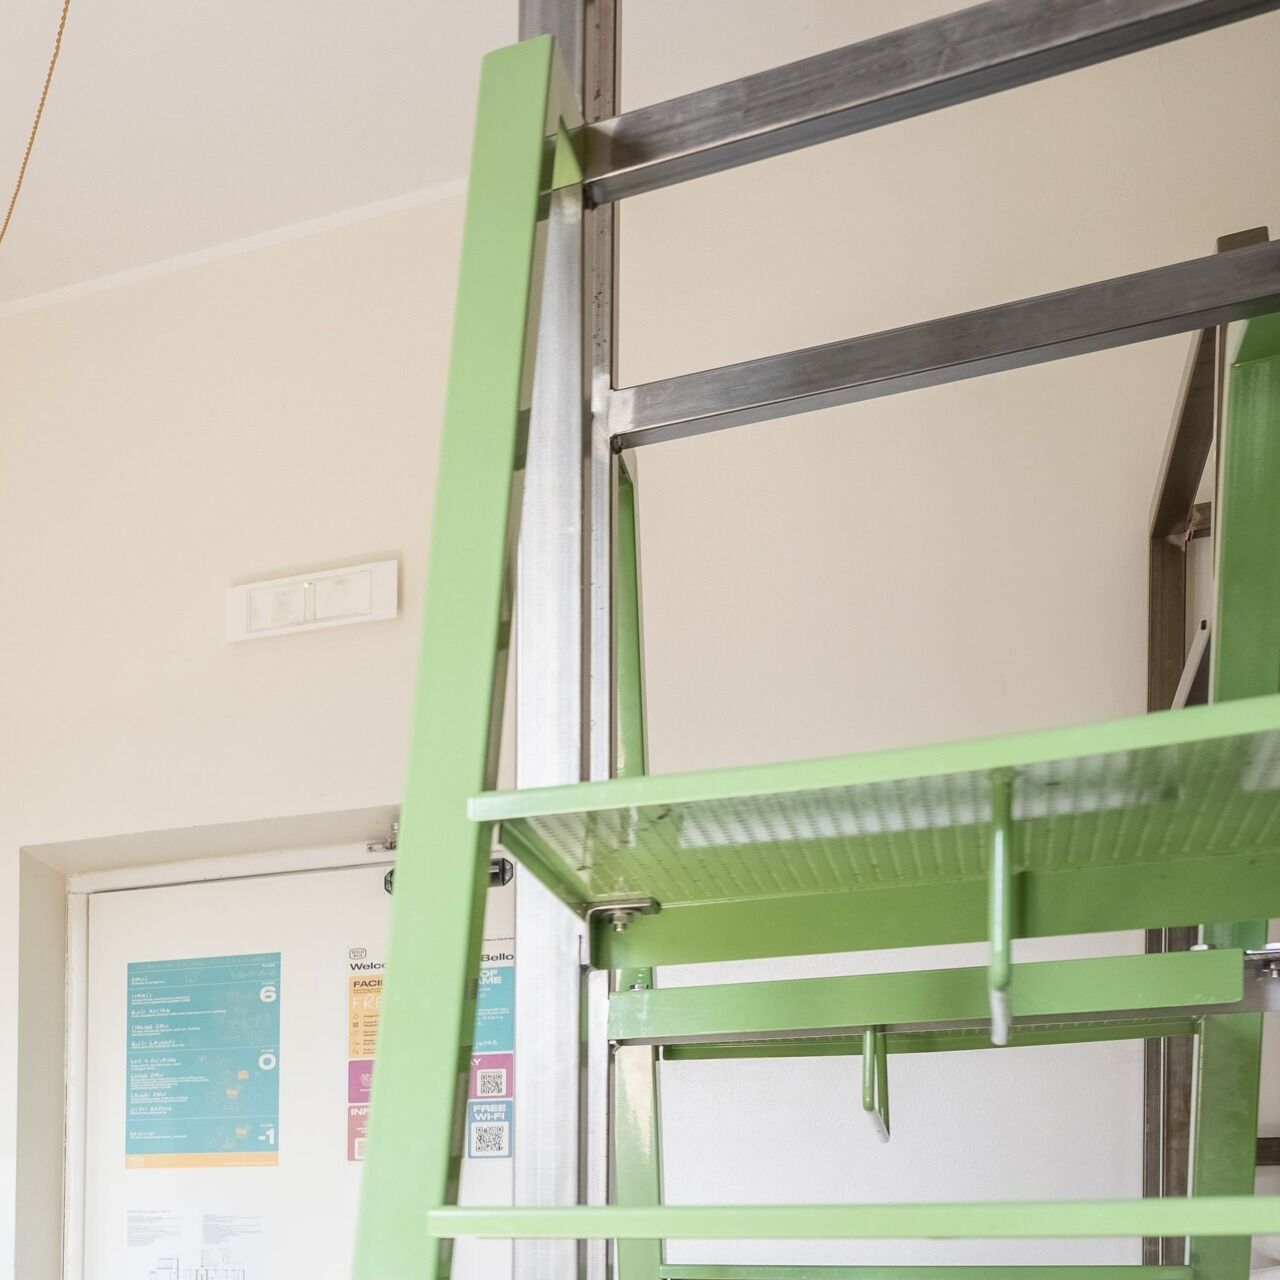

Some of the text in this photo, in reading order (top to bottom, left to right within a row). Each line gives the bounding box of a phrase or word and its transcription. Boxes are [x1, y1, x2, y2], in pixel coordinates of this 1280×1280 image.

[481, 953, 515, 962] Bello
[350, 961, 387, 971] Welc
[353, 979, 384, 989] FACI
[259, 985, 277, 1003] 6
[350, 1108, 369, 1117] INF
[473, 1104, 507, 1113] FREE
[474, 1112, 505, 1121] WI-FI
[258, 1127, 275, 1145] -1
